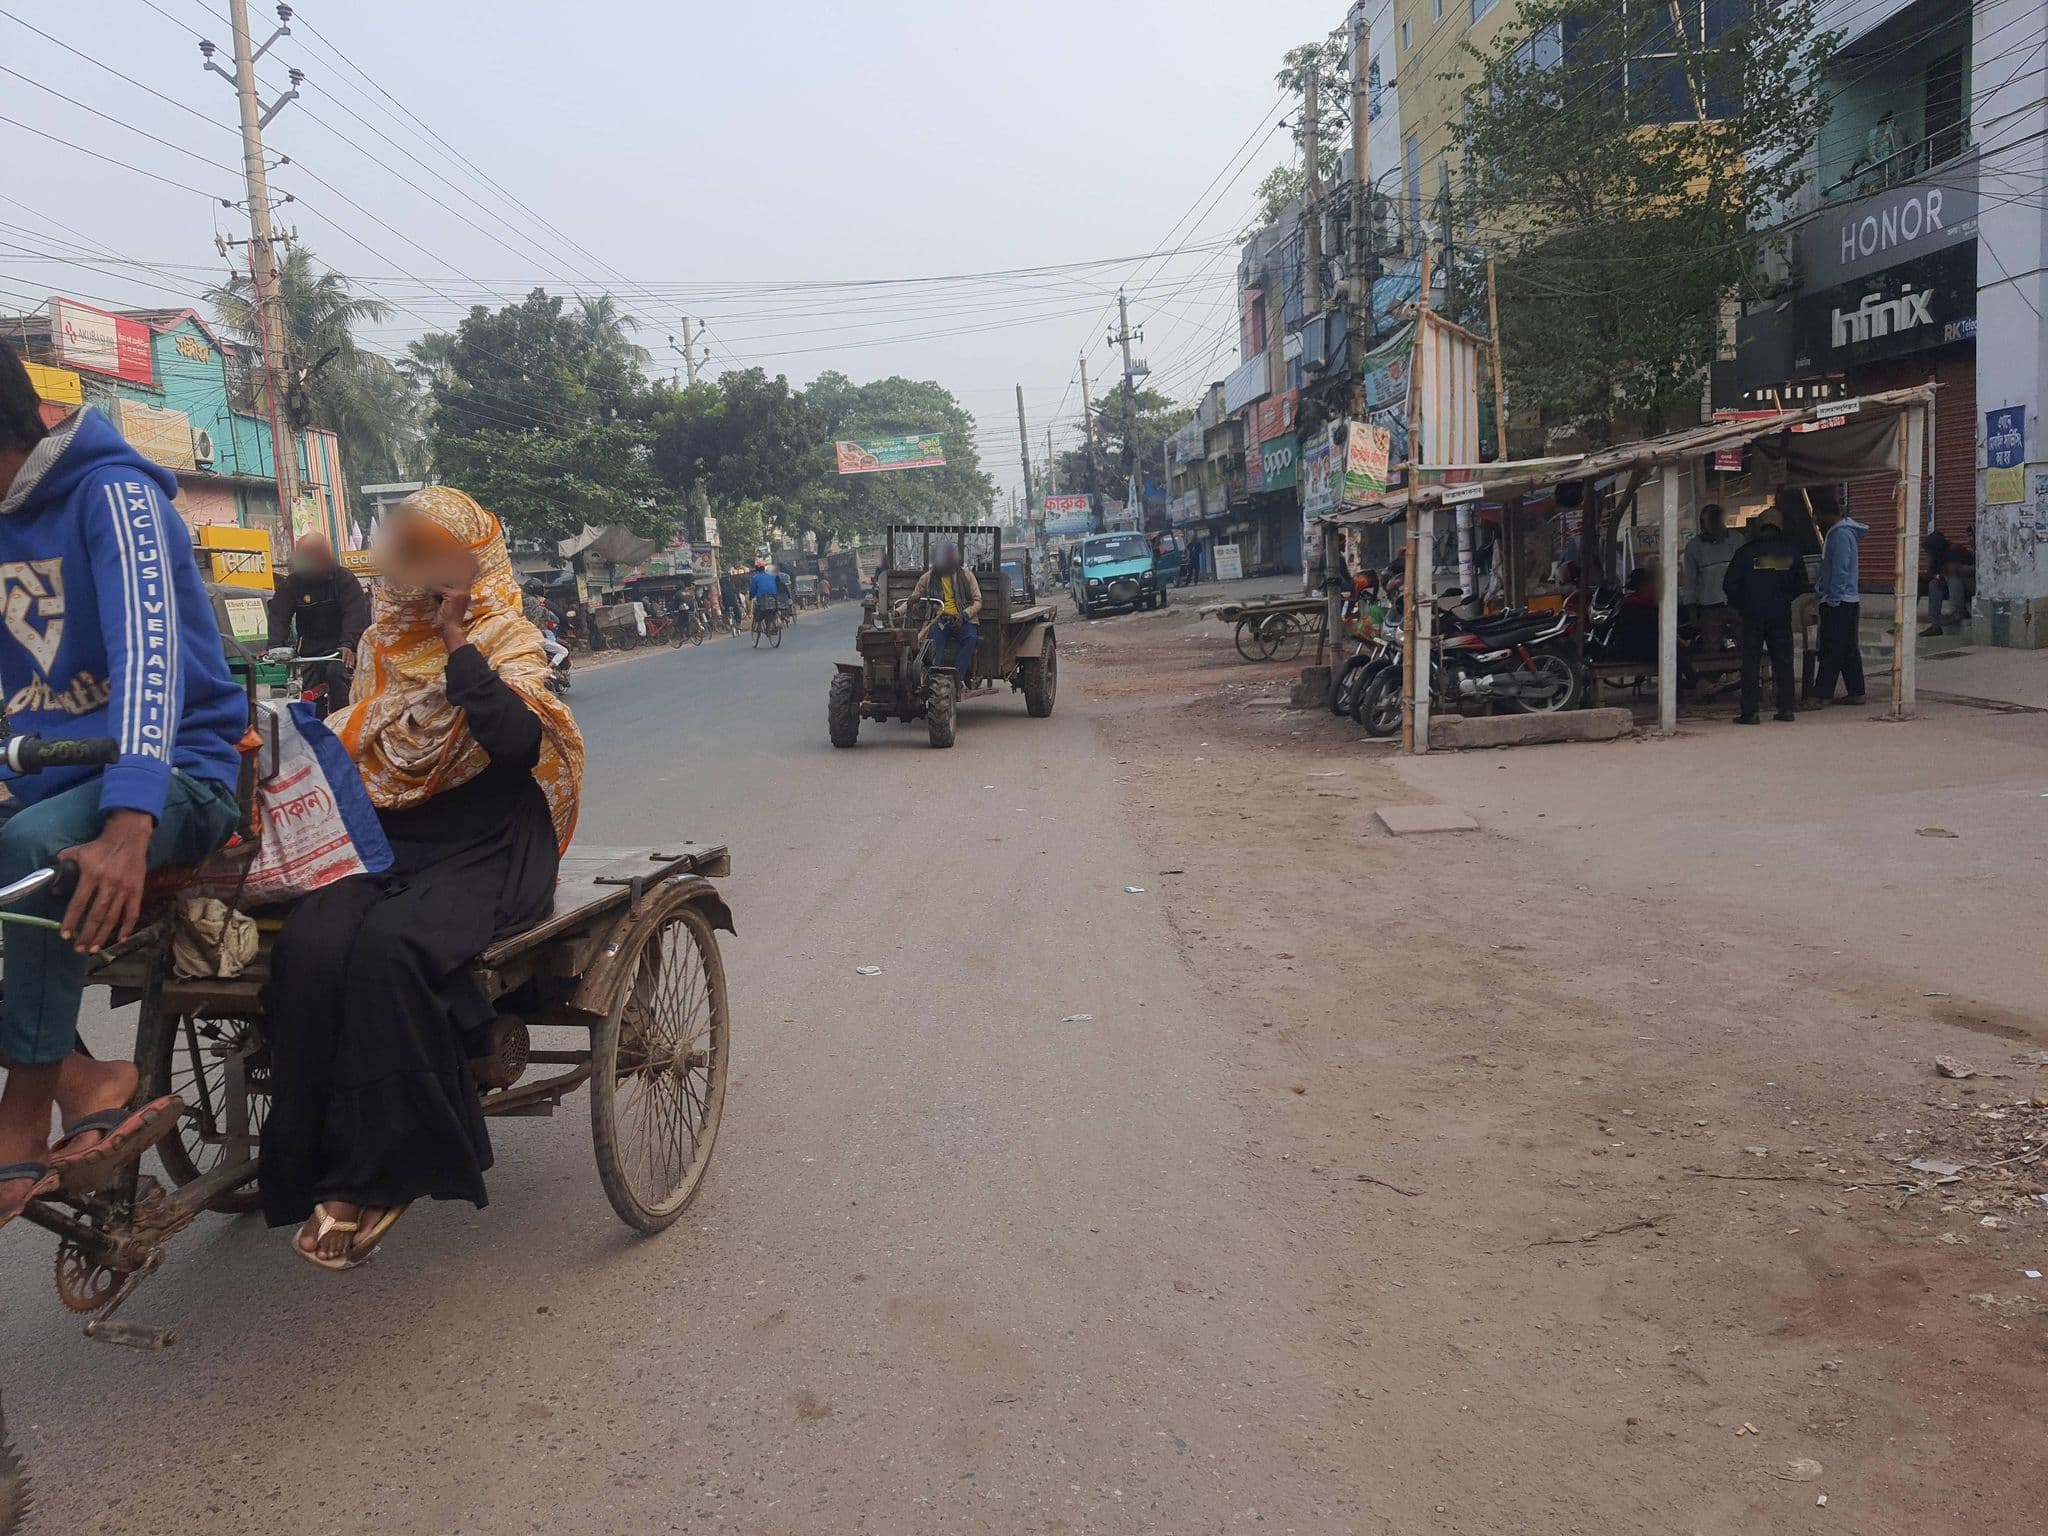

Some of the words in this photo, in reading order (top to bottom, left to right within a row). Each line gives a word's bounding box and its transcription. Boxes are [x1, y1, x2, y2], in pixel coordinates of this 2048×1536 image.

[1841, 188, 1943, 265] HONOR
[1831, 283, 1934, 348] Infinix
[1944, 323, 1961, 341] RK
[125, 482, 165, 631] EXCLUSIVE
[141, 636, 167, 759] FASHION
